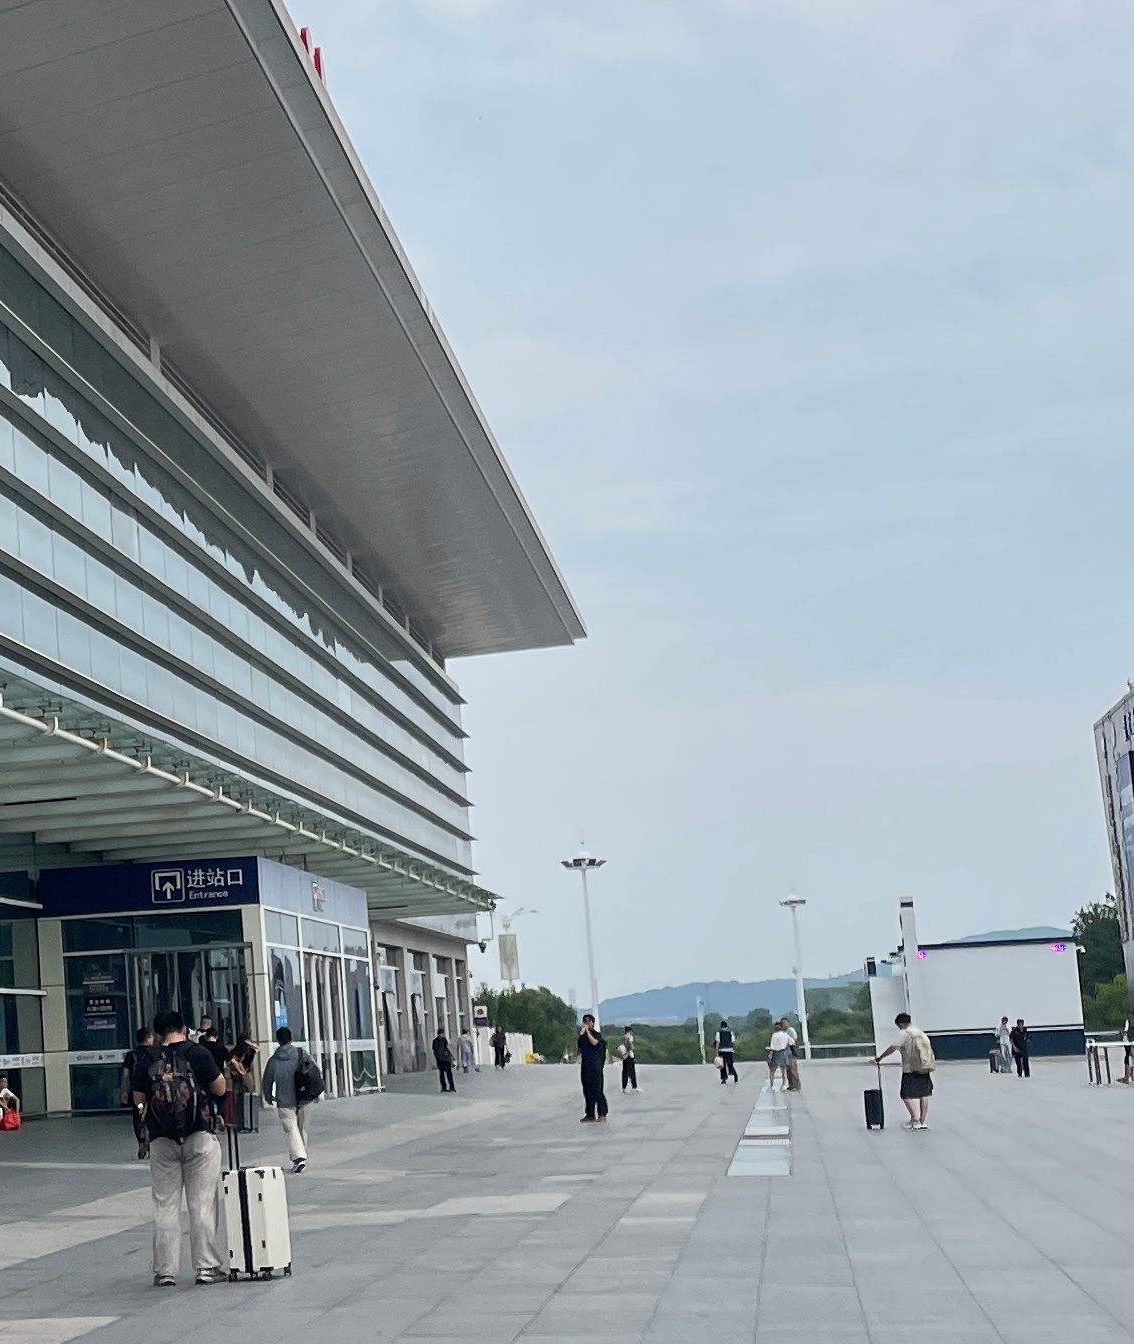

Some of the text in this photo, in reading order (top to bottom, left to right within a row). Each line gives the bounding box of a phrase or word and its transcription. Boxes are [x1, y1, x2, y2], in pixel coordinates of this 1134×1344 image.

[186, 867, 243, 888] 进站口
[188, 890, 229, 900] Entrance
